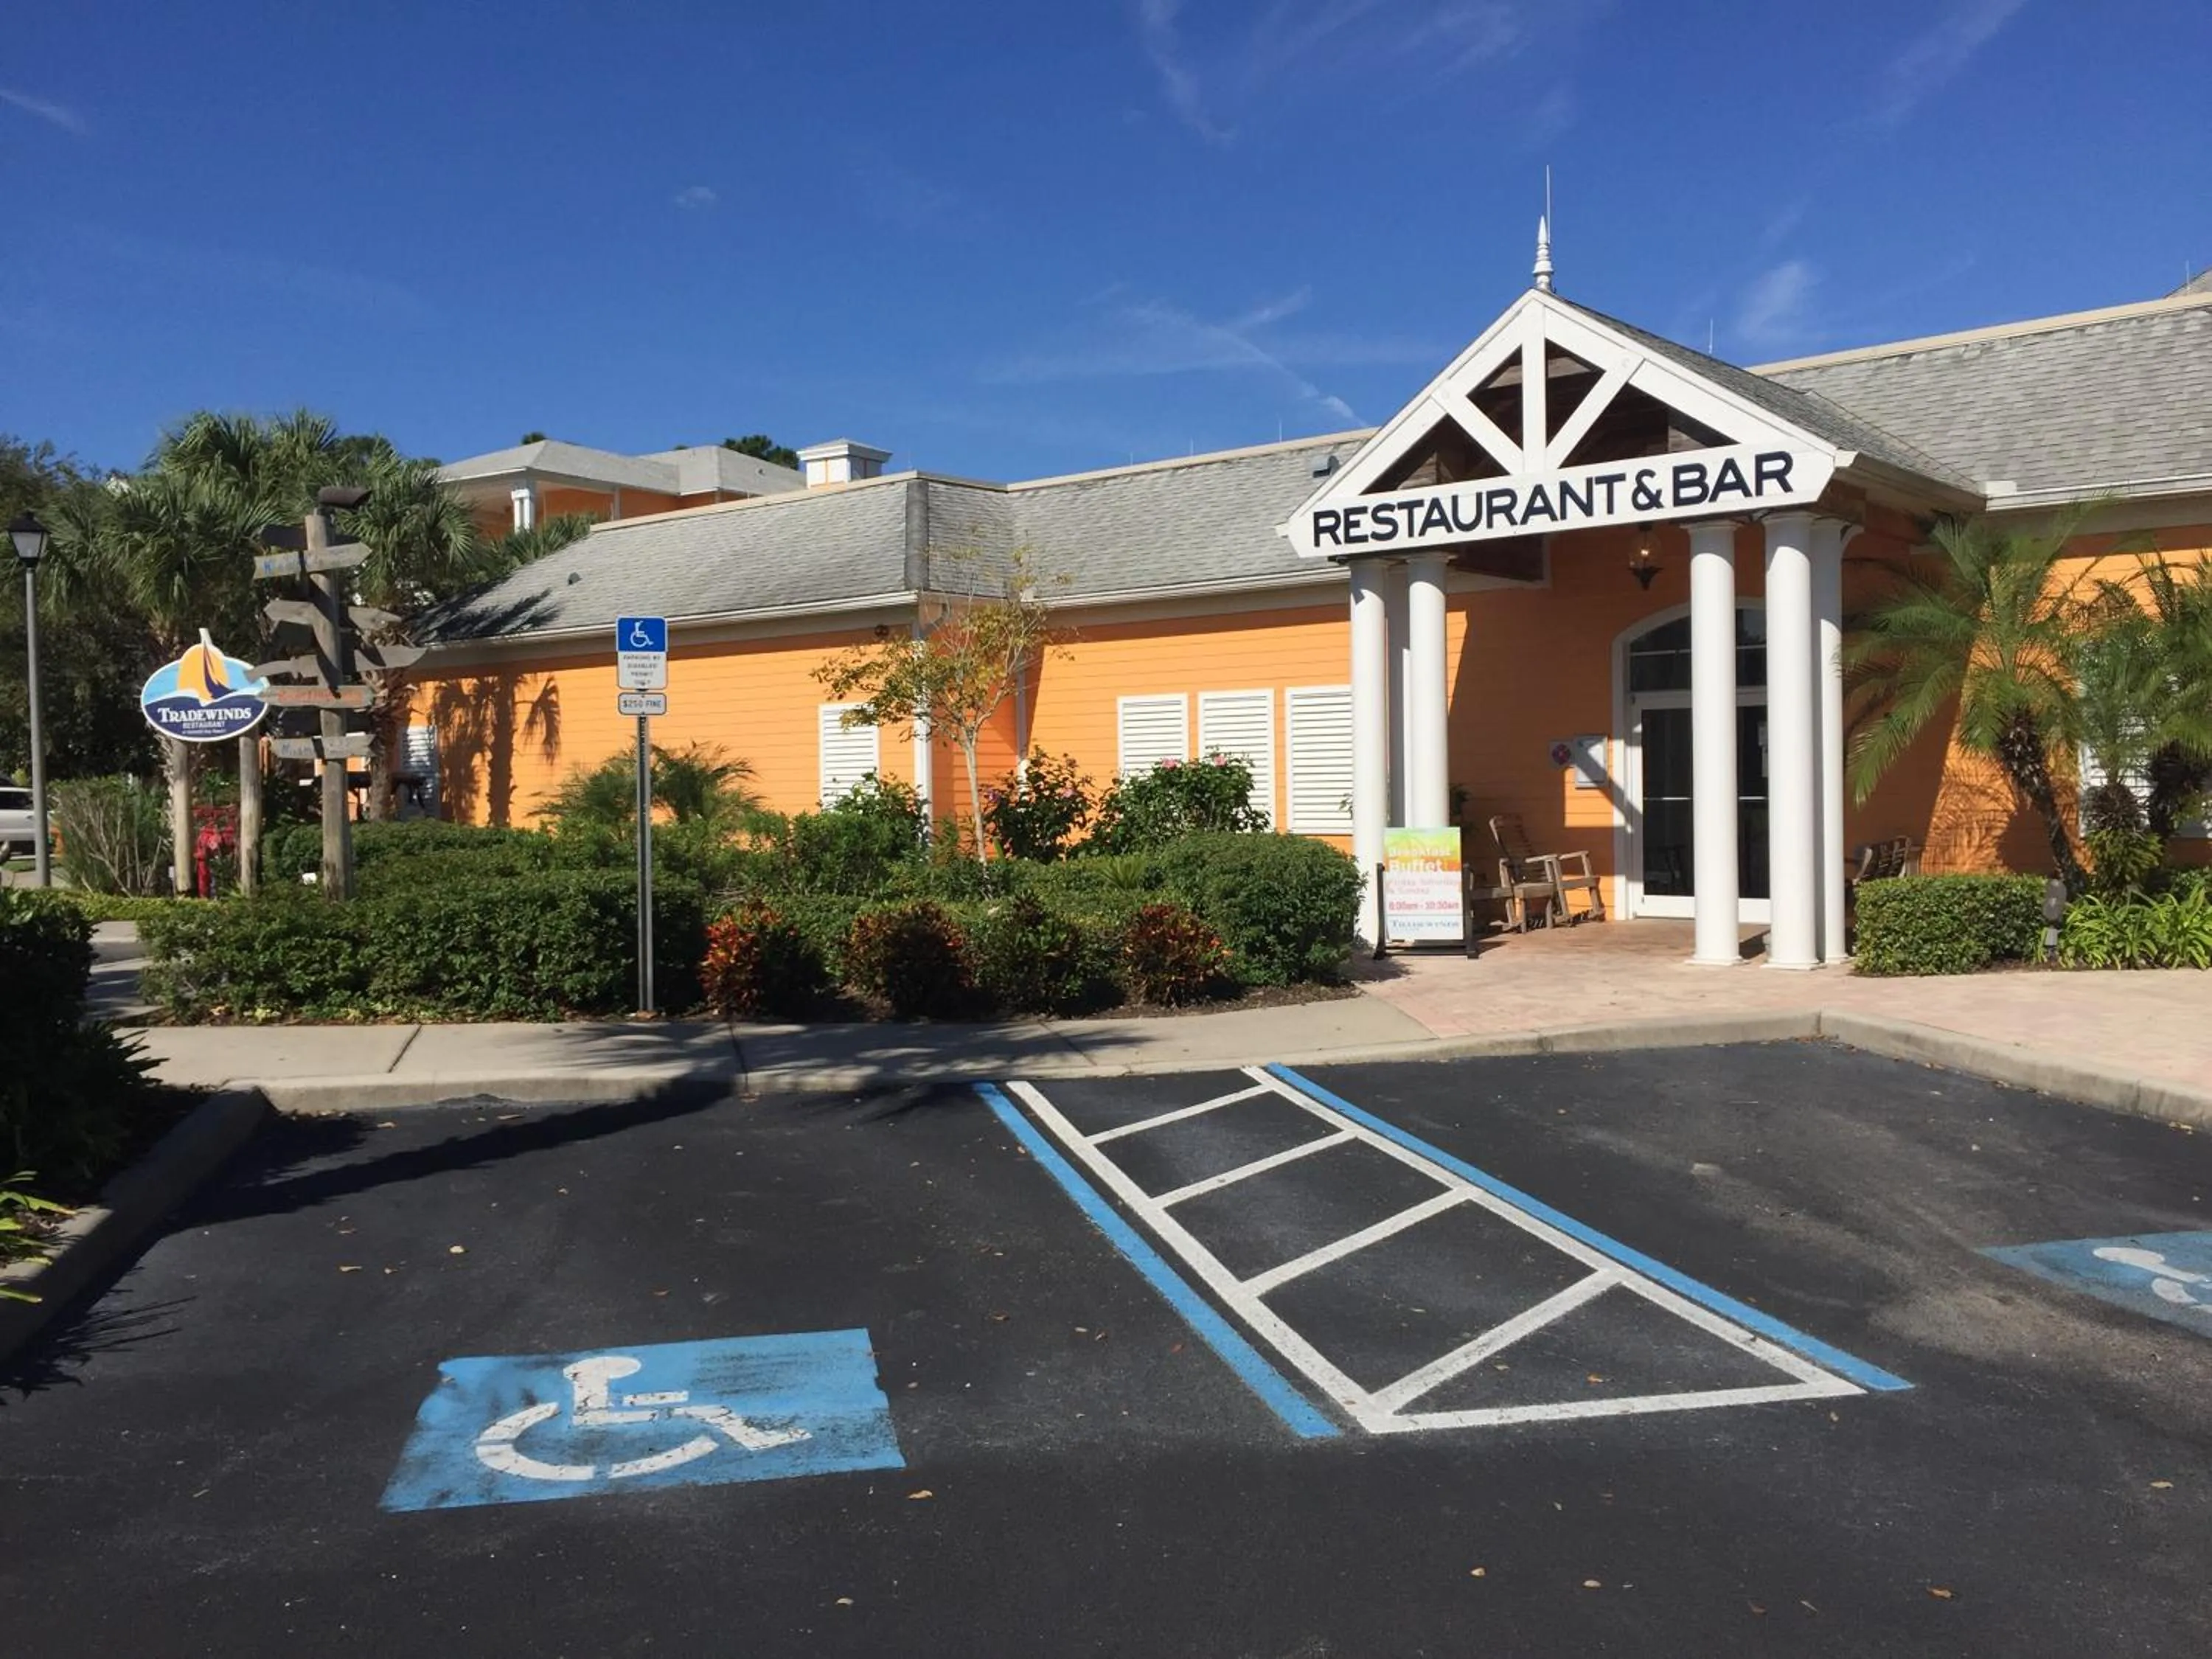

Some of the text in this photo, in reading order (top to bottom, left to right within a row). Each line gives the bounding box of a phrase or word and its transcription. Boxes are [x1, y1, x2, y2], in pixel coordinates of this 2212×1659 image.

[1312, 451, 1794, 548] RESTAURANT & BAR
[622, 700, 661, 709] $250 FINE
[157, 707, 252, 723] TRADEWINDS
[182, 721, 226, 729] RESTAURANT
